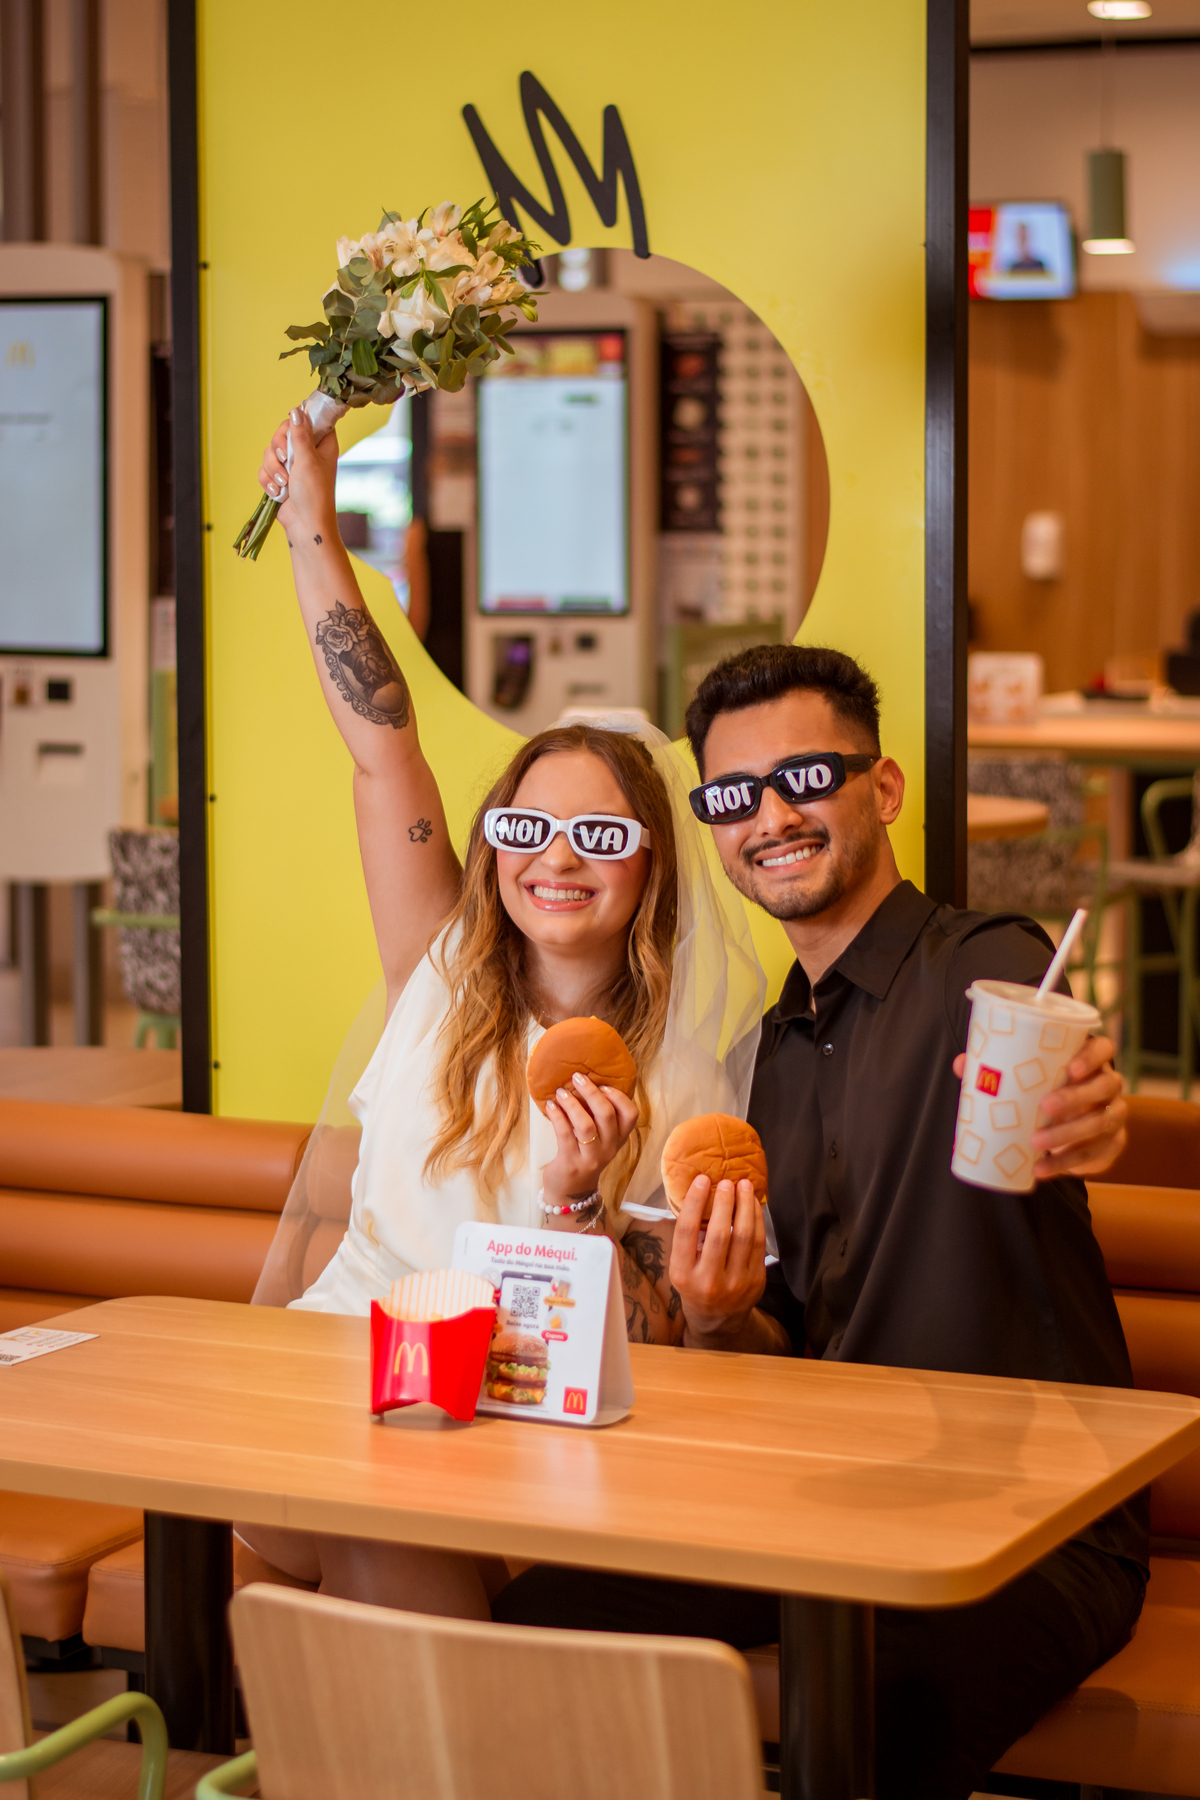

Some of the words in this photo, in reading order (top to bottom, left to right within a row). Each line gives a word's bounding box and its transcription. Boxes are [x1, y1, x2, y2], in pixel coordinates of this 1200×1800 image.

[705, 782, 751, 816] NOI
[785, 763, 832, 794] VO
[499, 816, 543, 844] NOI
[580, 825, 623, 851] VA
[486, 1239, 513, 1257] App
[515, 1242, 532, 1256] do
[534, 1244, 578, 1263] Méqui.
